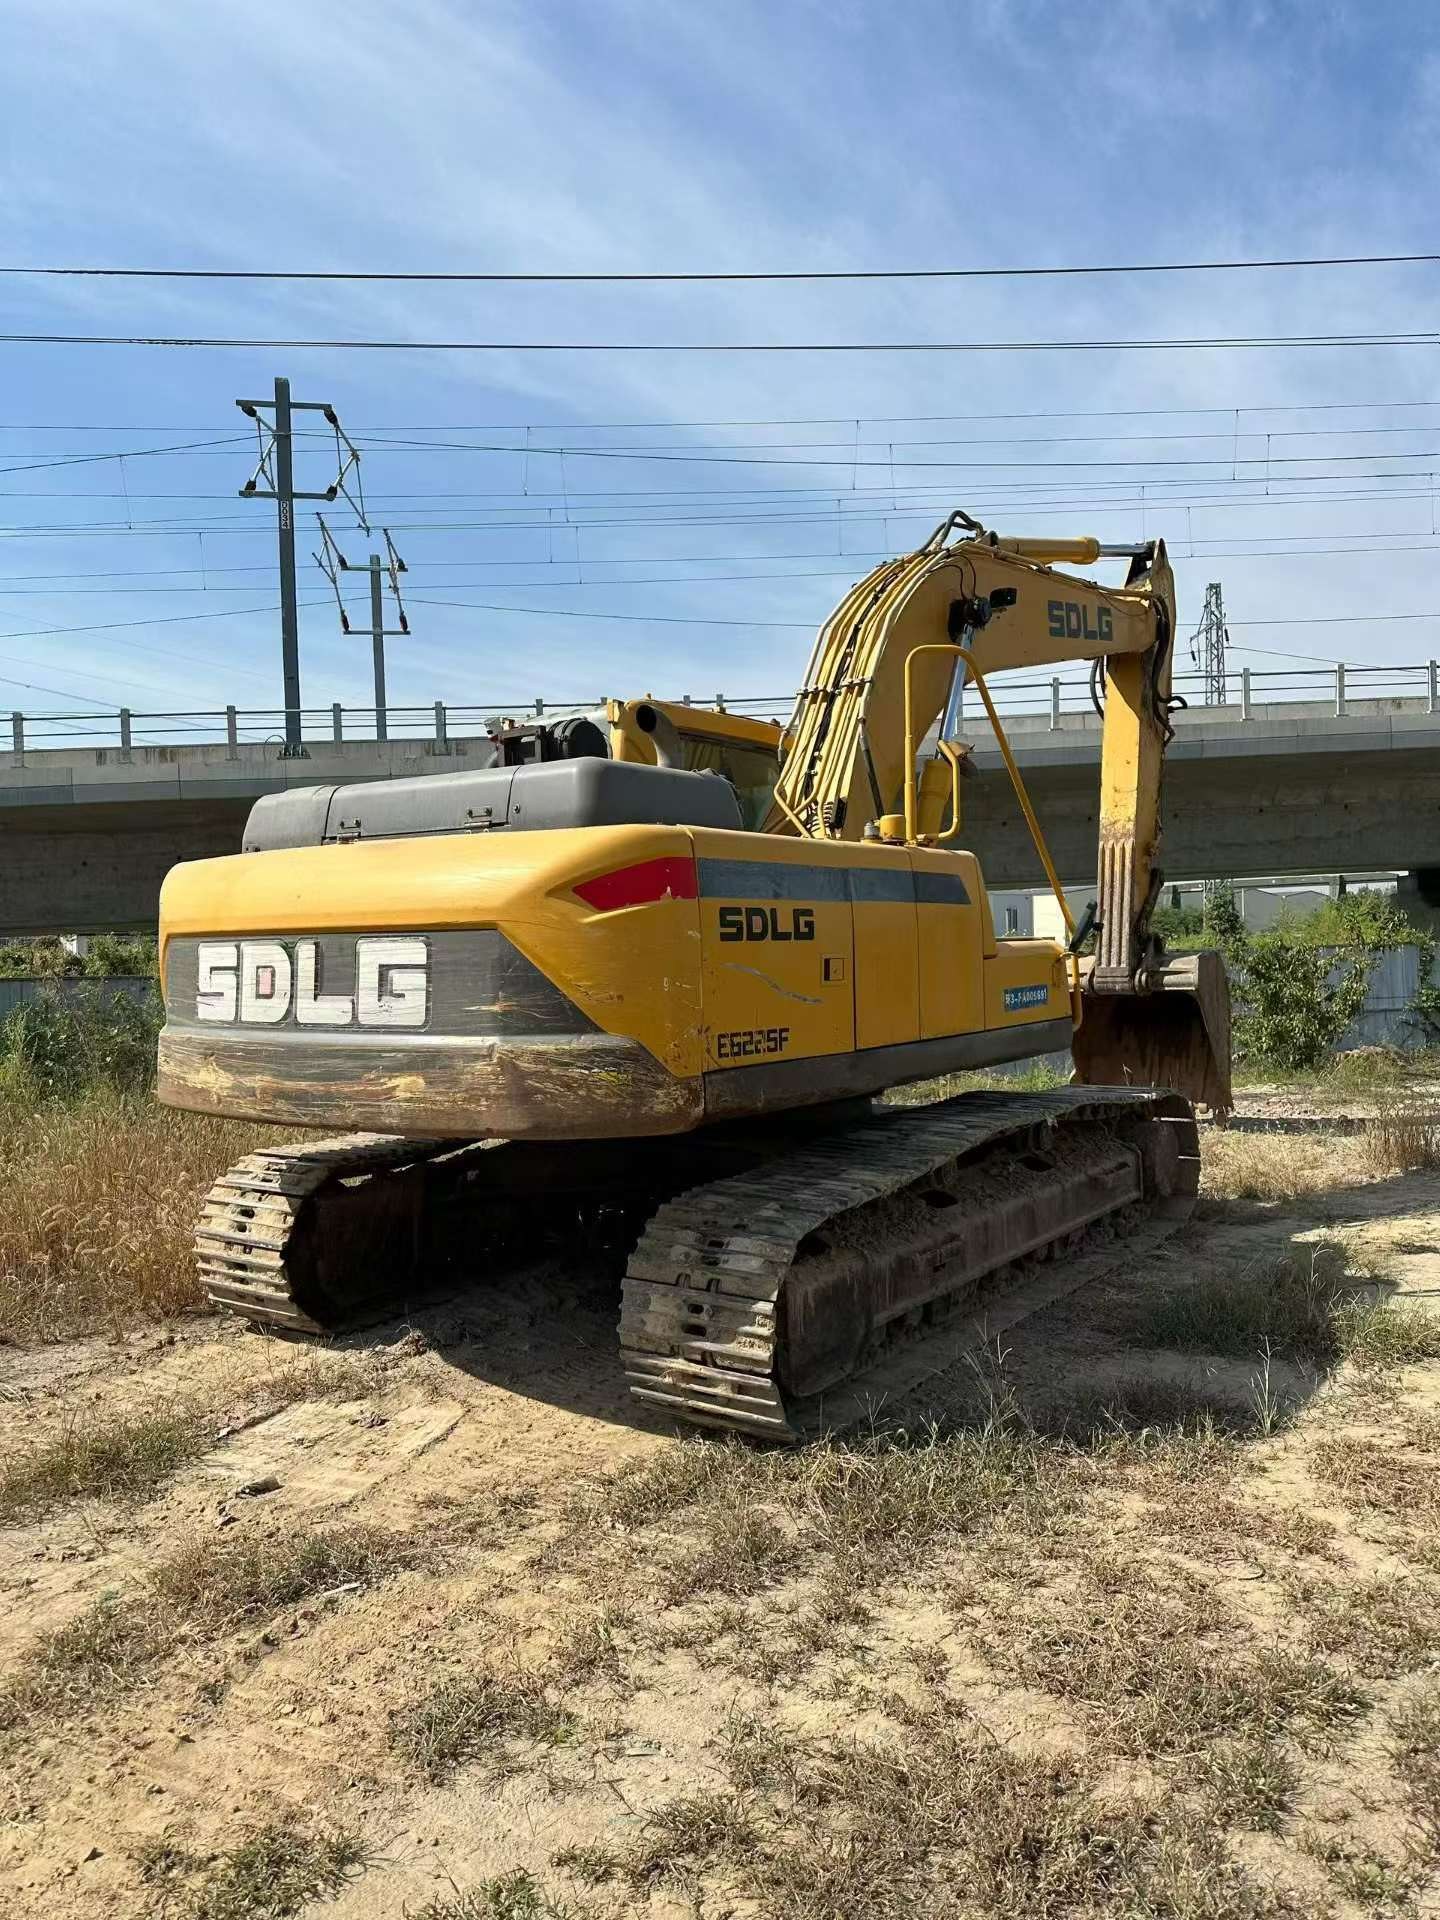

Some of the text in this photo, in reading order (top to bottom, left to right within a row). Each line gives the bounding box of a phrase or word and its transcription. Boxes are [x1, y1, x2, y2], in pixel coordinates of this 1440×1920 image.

[1047, 600, 1113, 641] SDLG
[719, 907, 815, 941] SDLG
[196, 937, 429, 1027] SDLG
